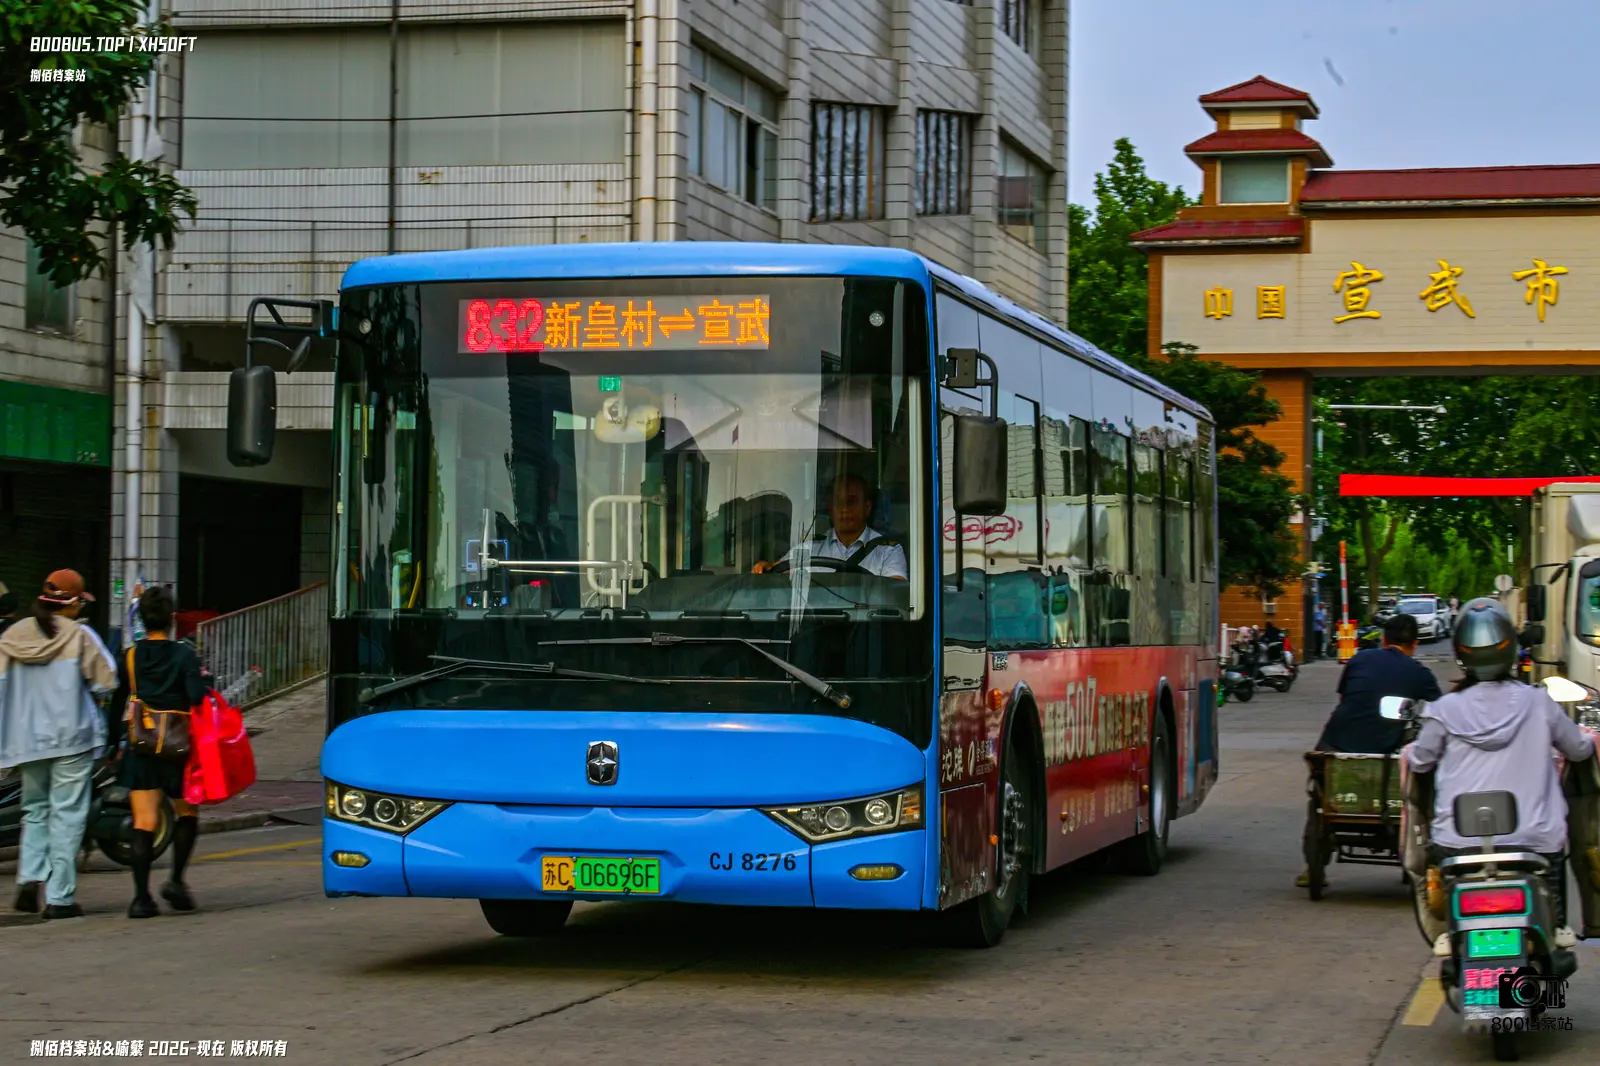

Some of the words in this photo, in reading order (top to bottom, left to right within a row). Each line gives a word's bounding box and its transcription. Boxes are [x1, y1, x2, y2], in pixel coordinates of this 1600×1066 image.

[1204, 285, 1287, 320] 中国
[1332, 258, 1571, 323] 宣武市
[466, 299, 545, 352] 832
[544, 299, 657, 349] 新皇村
[698, 297, 770, 345] 宣武
[580, 862, 657, 888] 06696F
[709, 853, 733, 872] CJ
[741, 853, 797, 872] 8276
